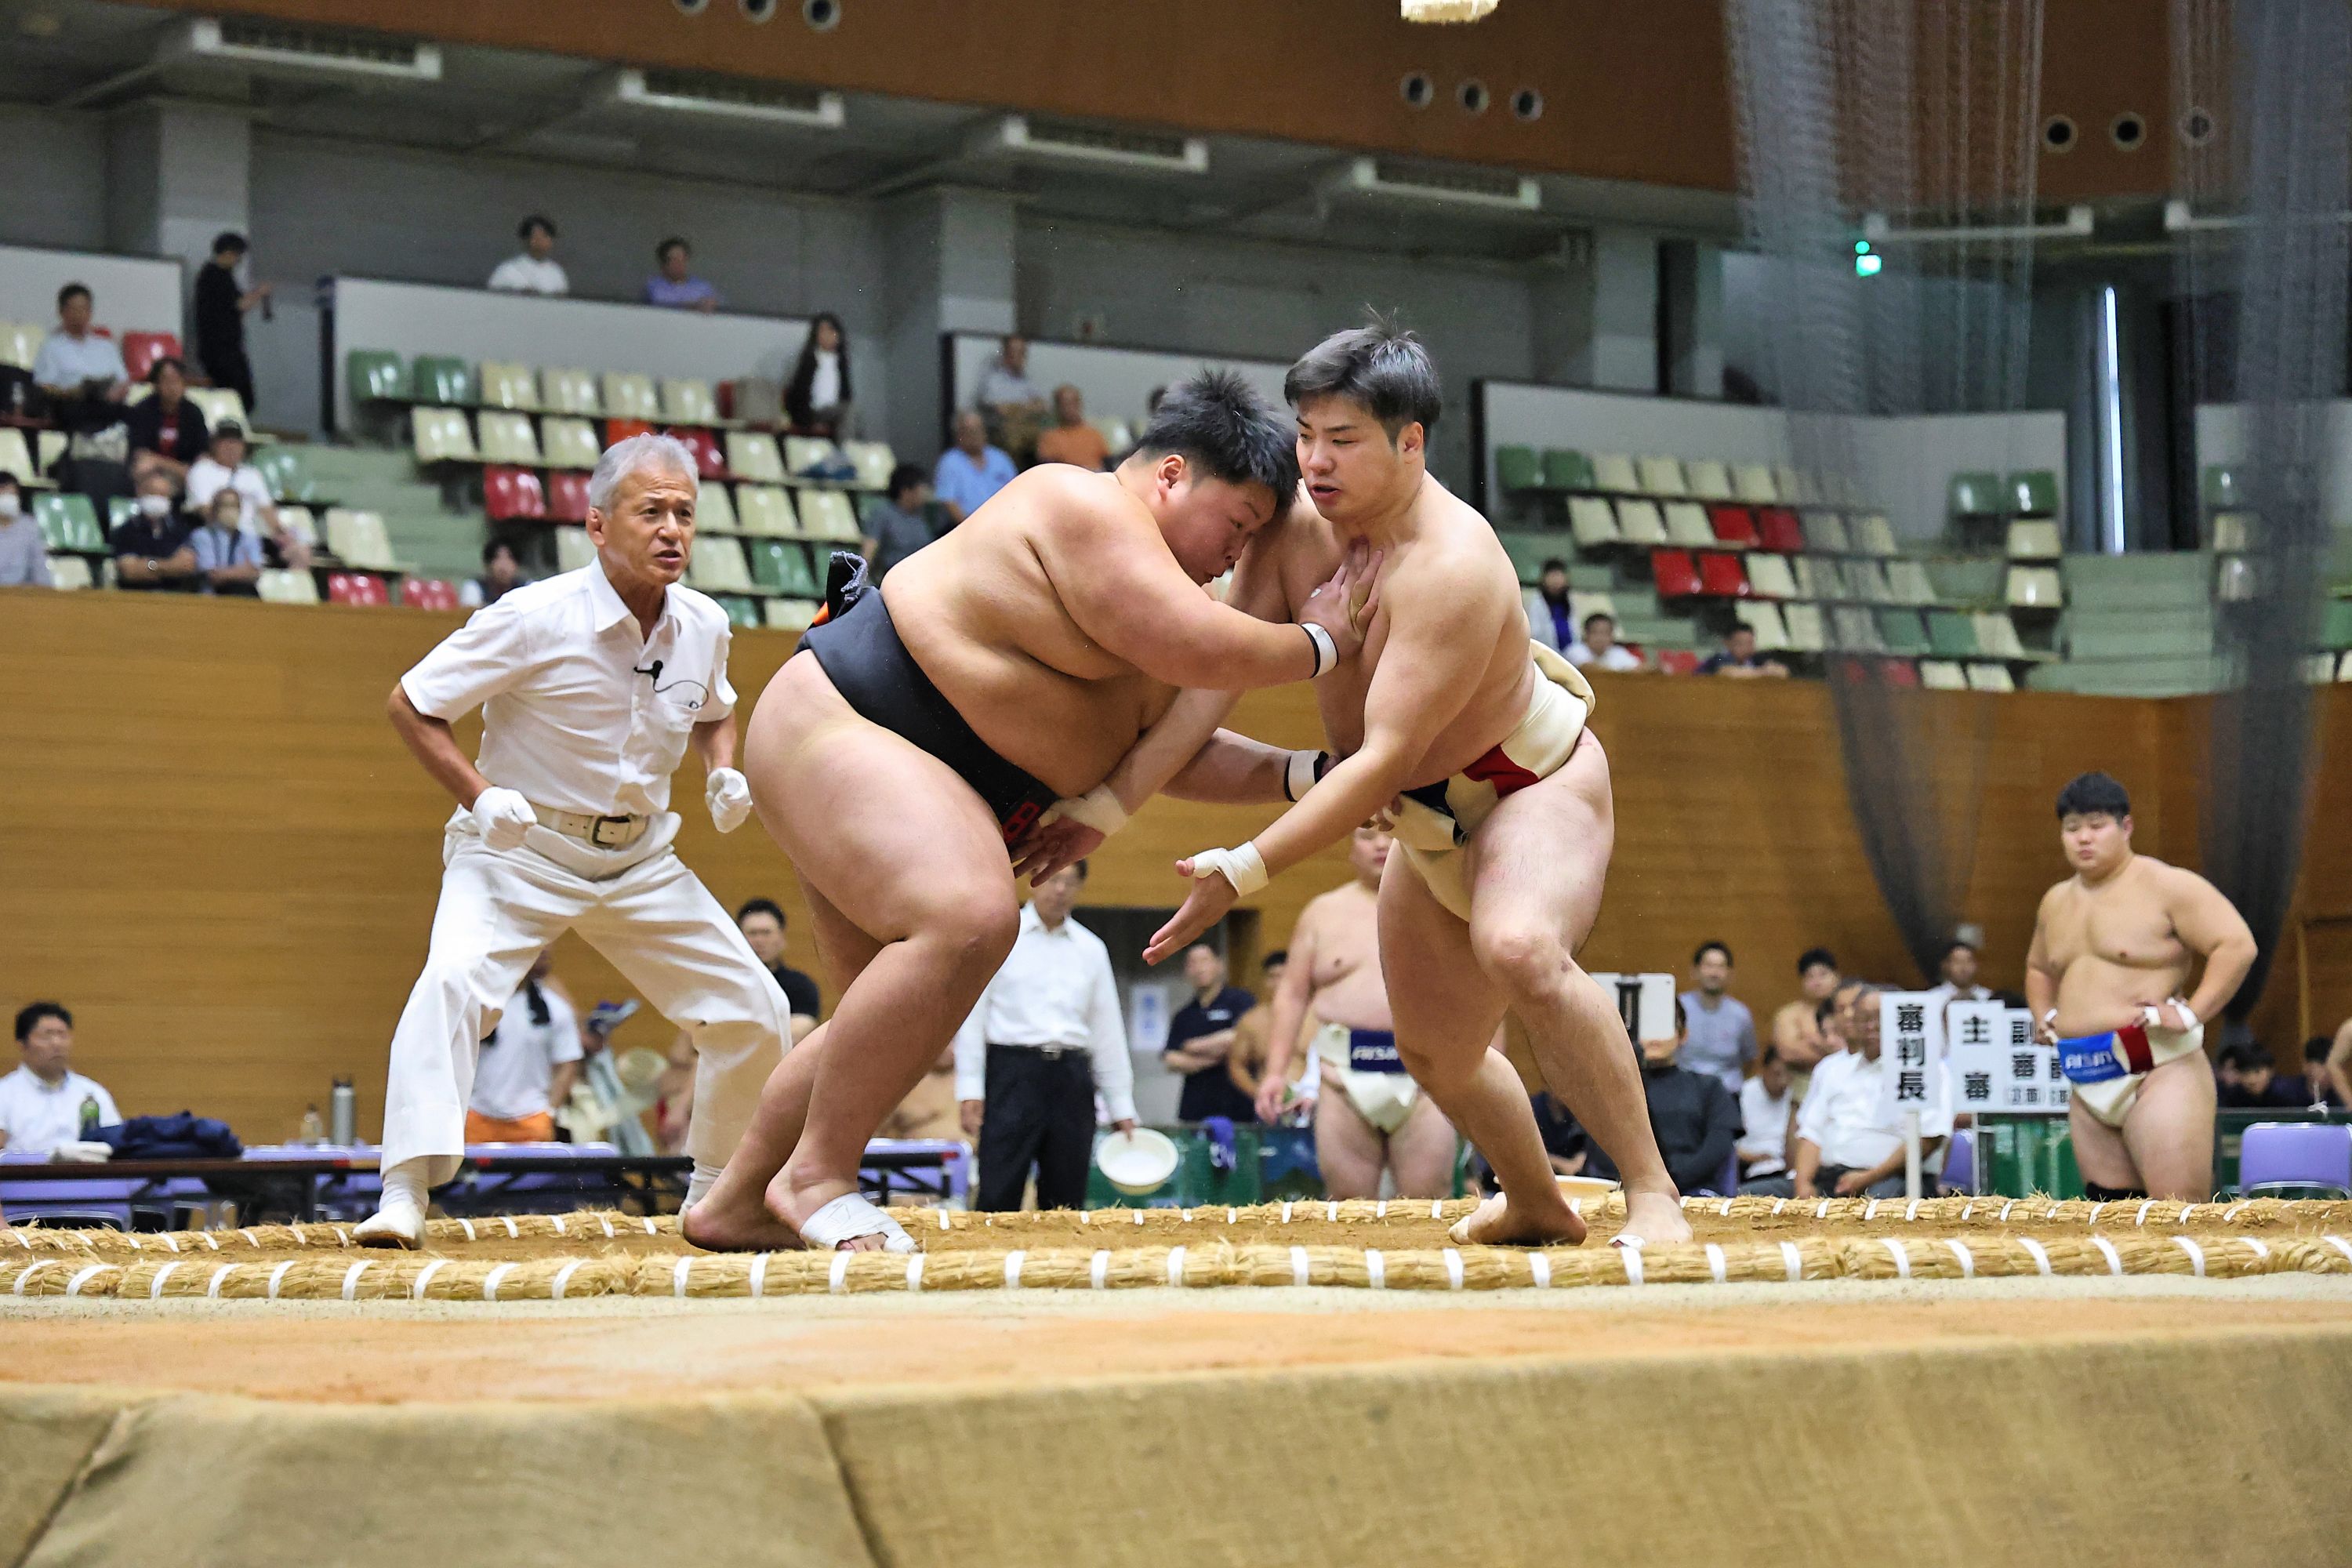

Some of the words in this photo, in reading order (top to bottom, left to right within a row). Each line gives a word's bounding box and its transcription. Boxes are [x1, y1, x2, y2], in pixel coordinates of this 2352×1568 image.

[1896, 1004, 1926, 1100] 審判長
[1962, 1014, 1991, 1100] 主審
